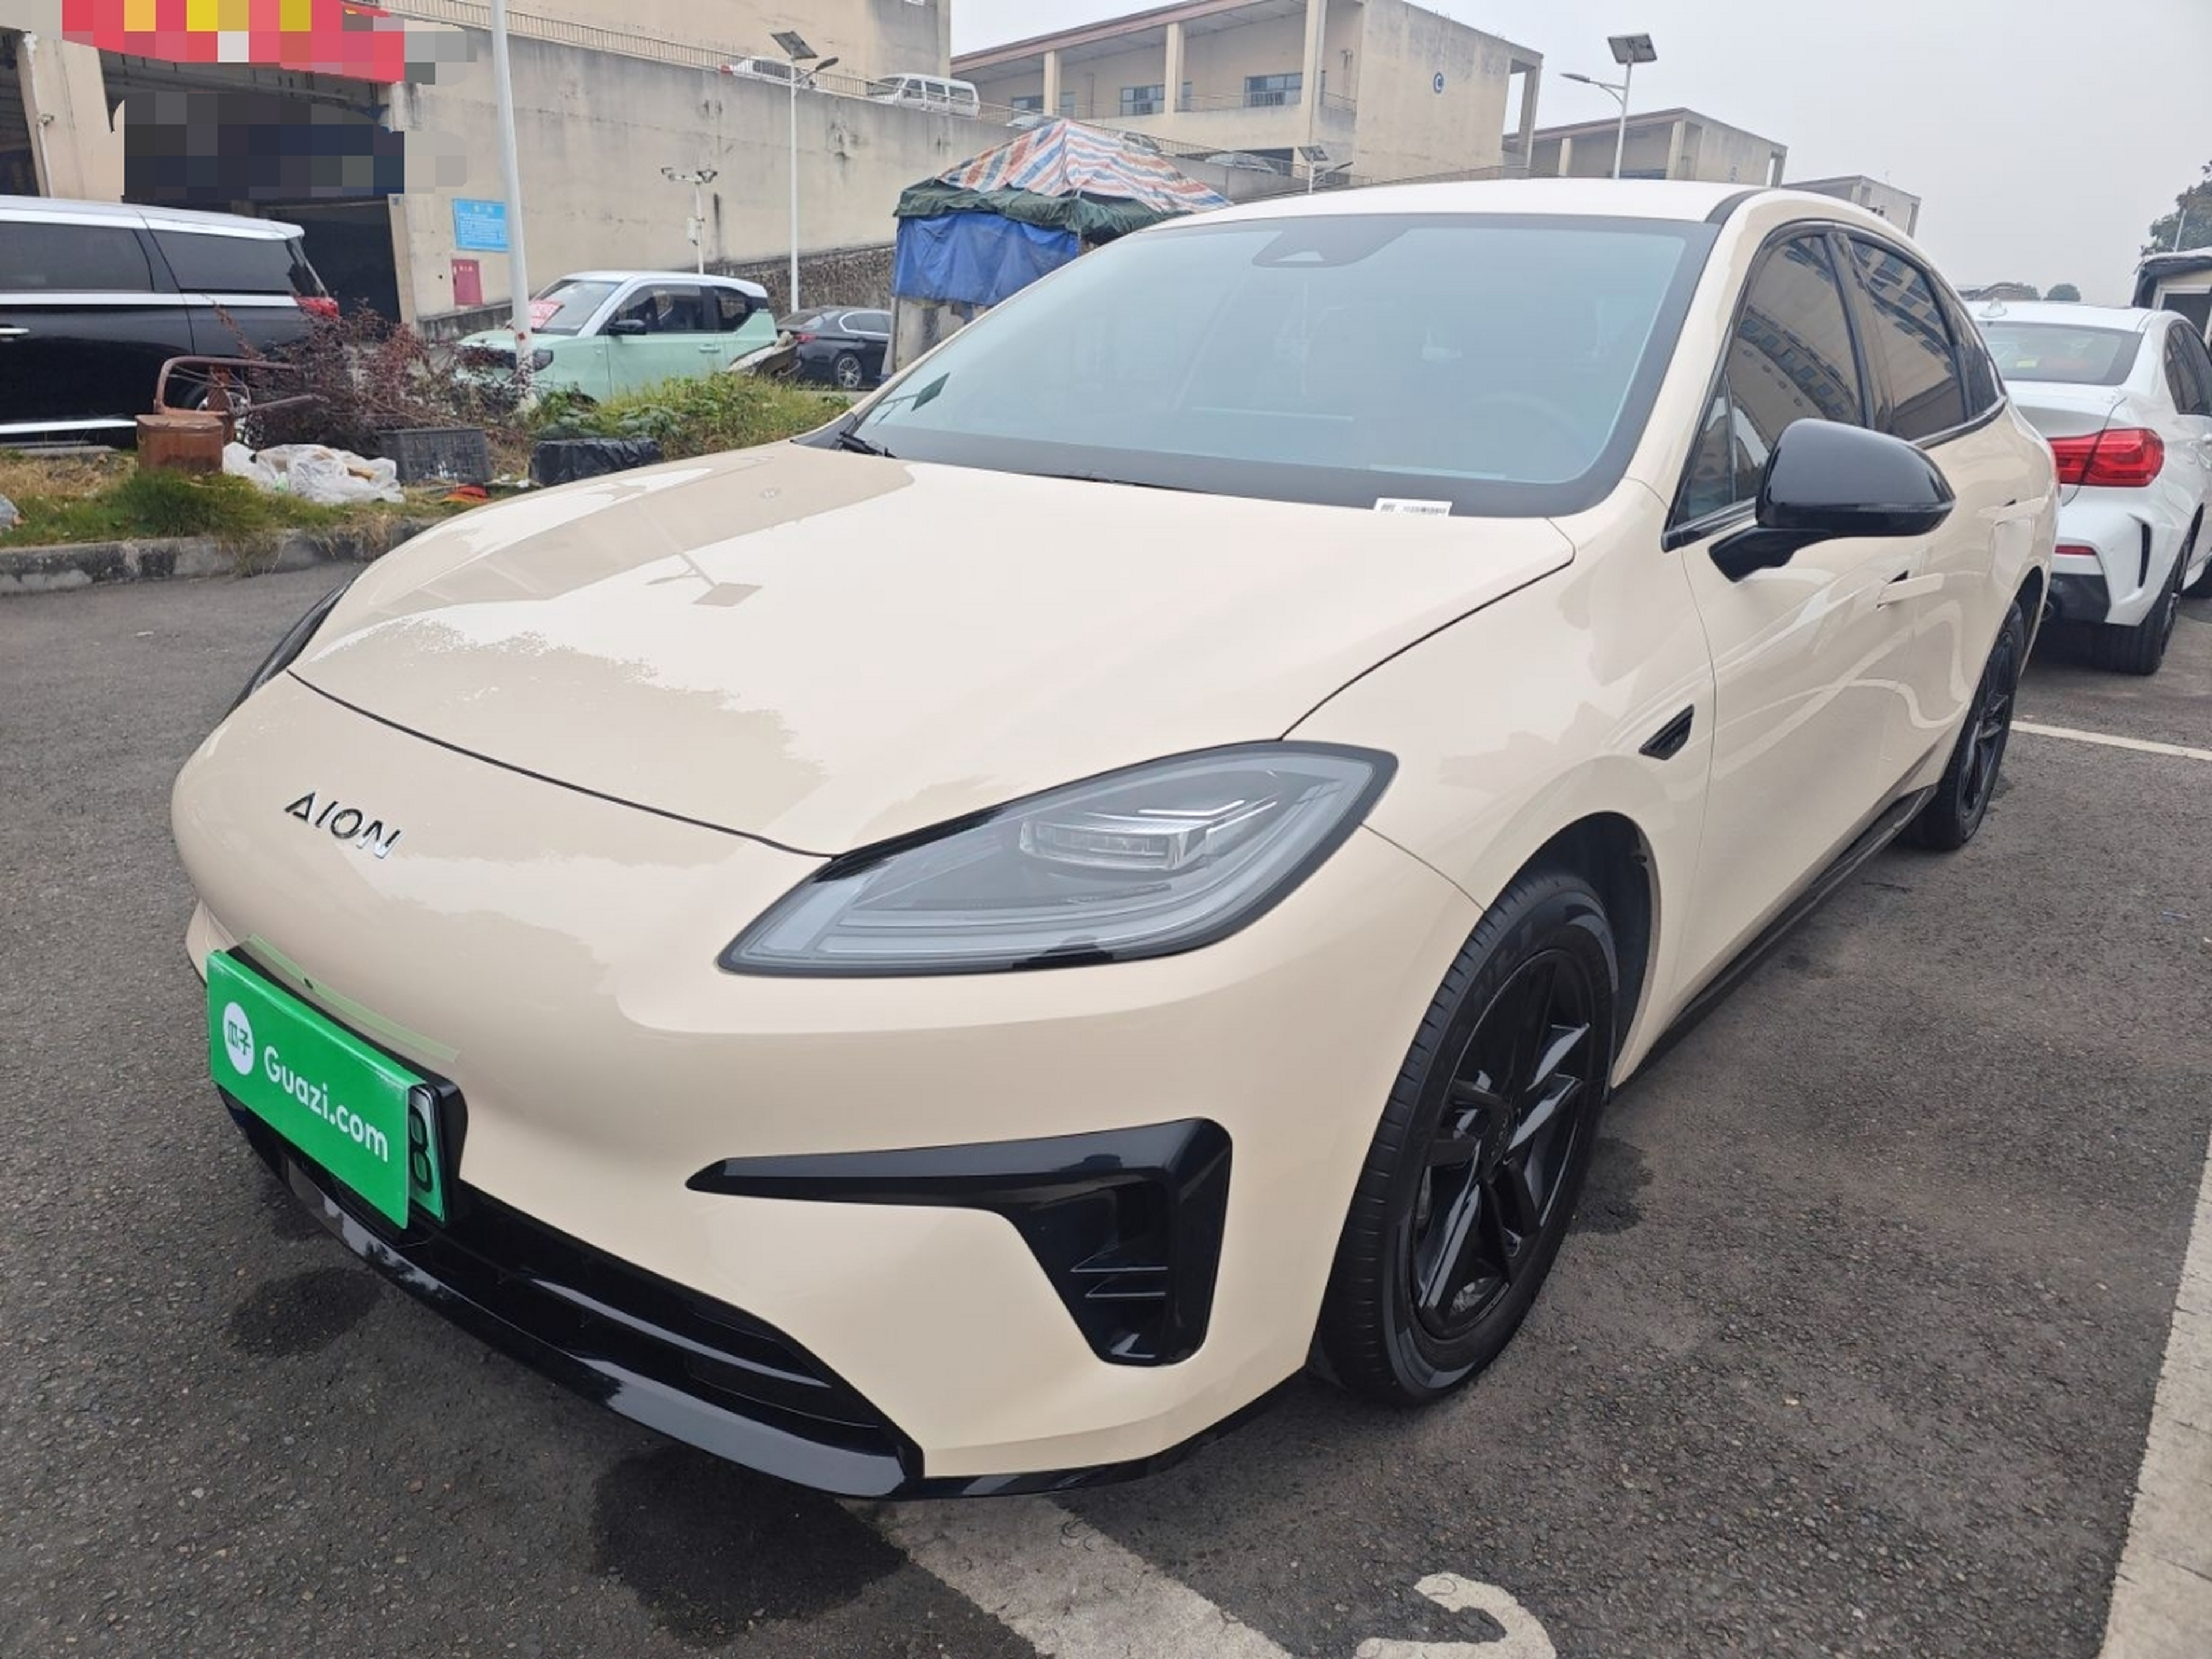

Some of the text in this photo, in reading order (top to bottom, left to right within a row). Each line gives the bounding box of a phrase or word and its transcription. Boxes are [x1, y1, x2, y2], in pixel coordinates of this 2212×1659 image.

[284, 791, 402, 859] AION
[228, 1019, 251, 1056] 瓜子
[264, 1045, 388, 1162] Guazi.com
